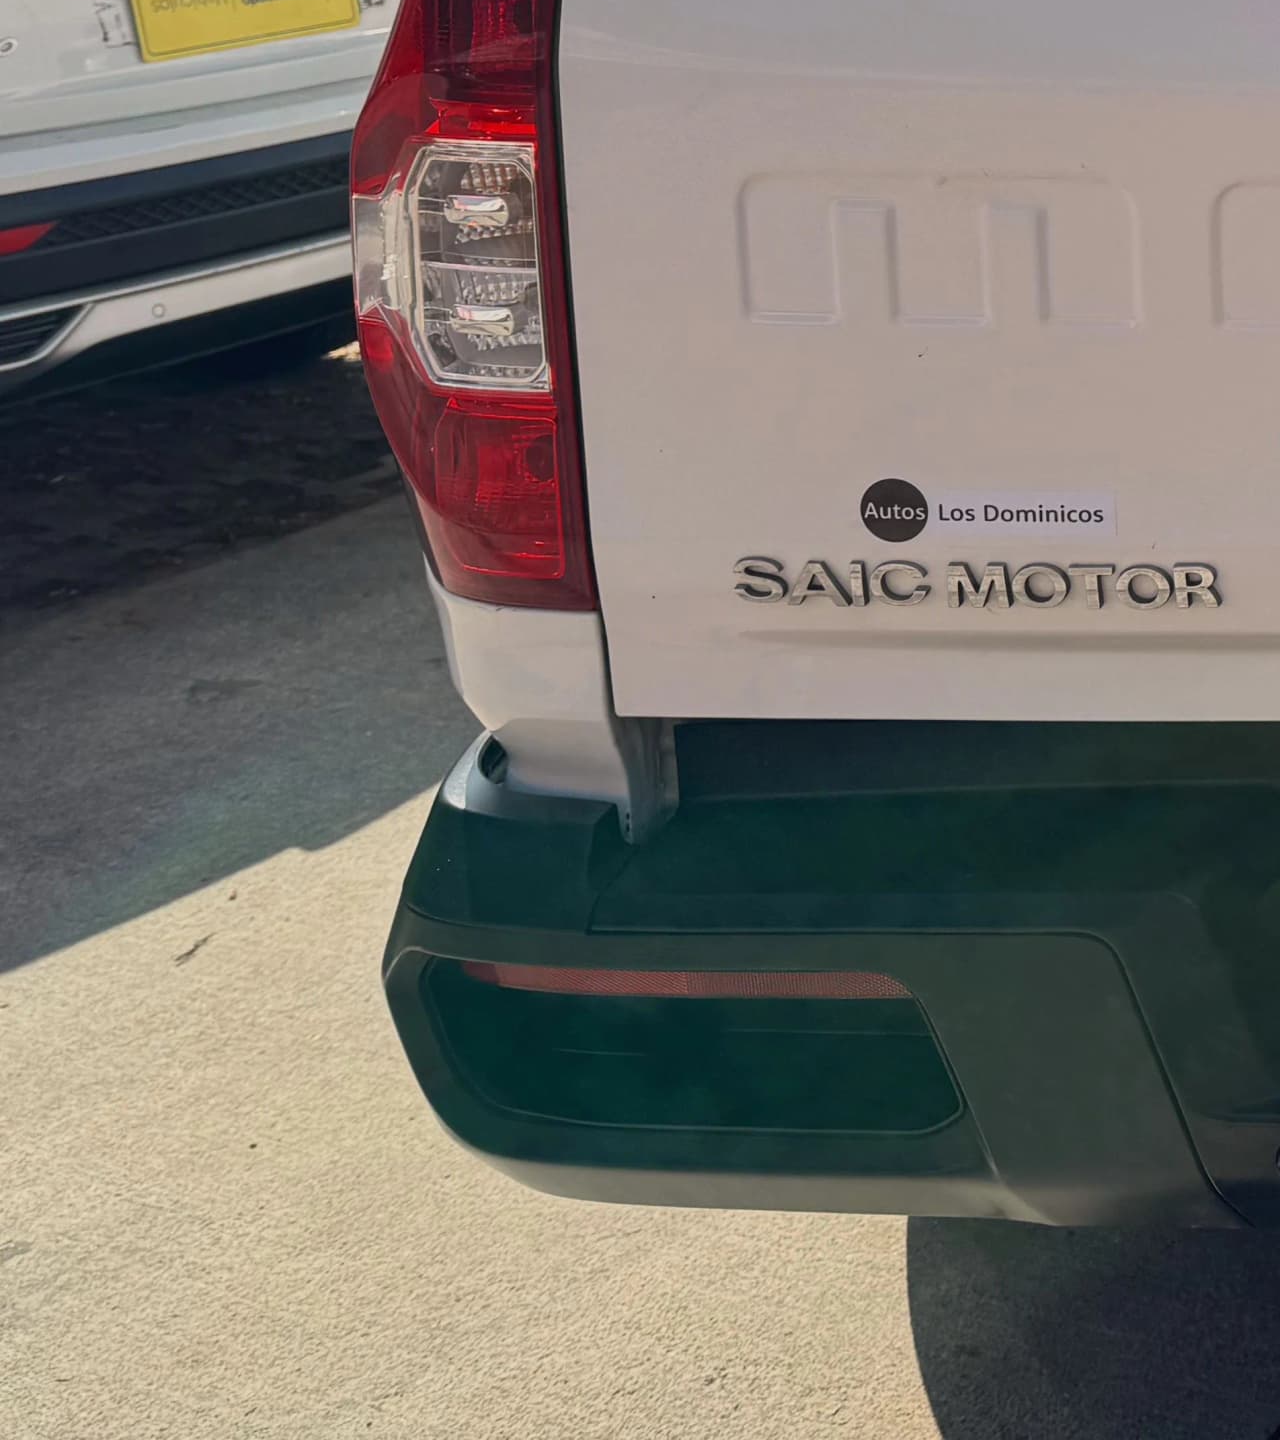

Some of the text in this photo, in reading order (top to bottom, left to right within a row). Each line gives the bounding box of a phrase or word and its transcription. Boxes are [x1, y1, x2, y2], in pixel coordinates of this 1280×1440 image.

[863, 501, 1104, 523] Autos Los Dominicos
[733, 556, 1223, 610] SAIC MOTOR
